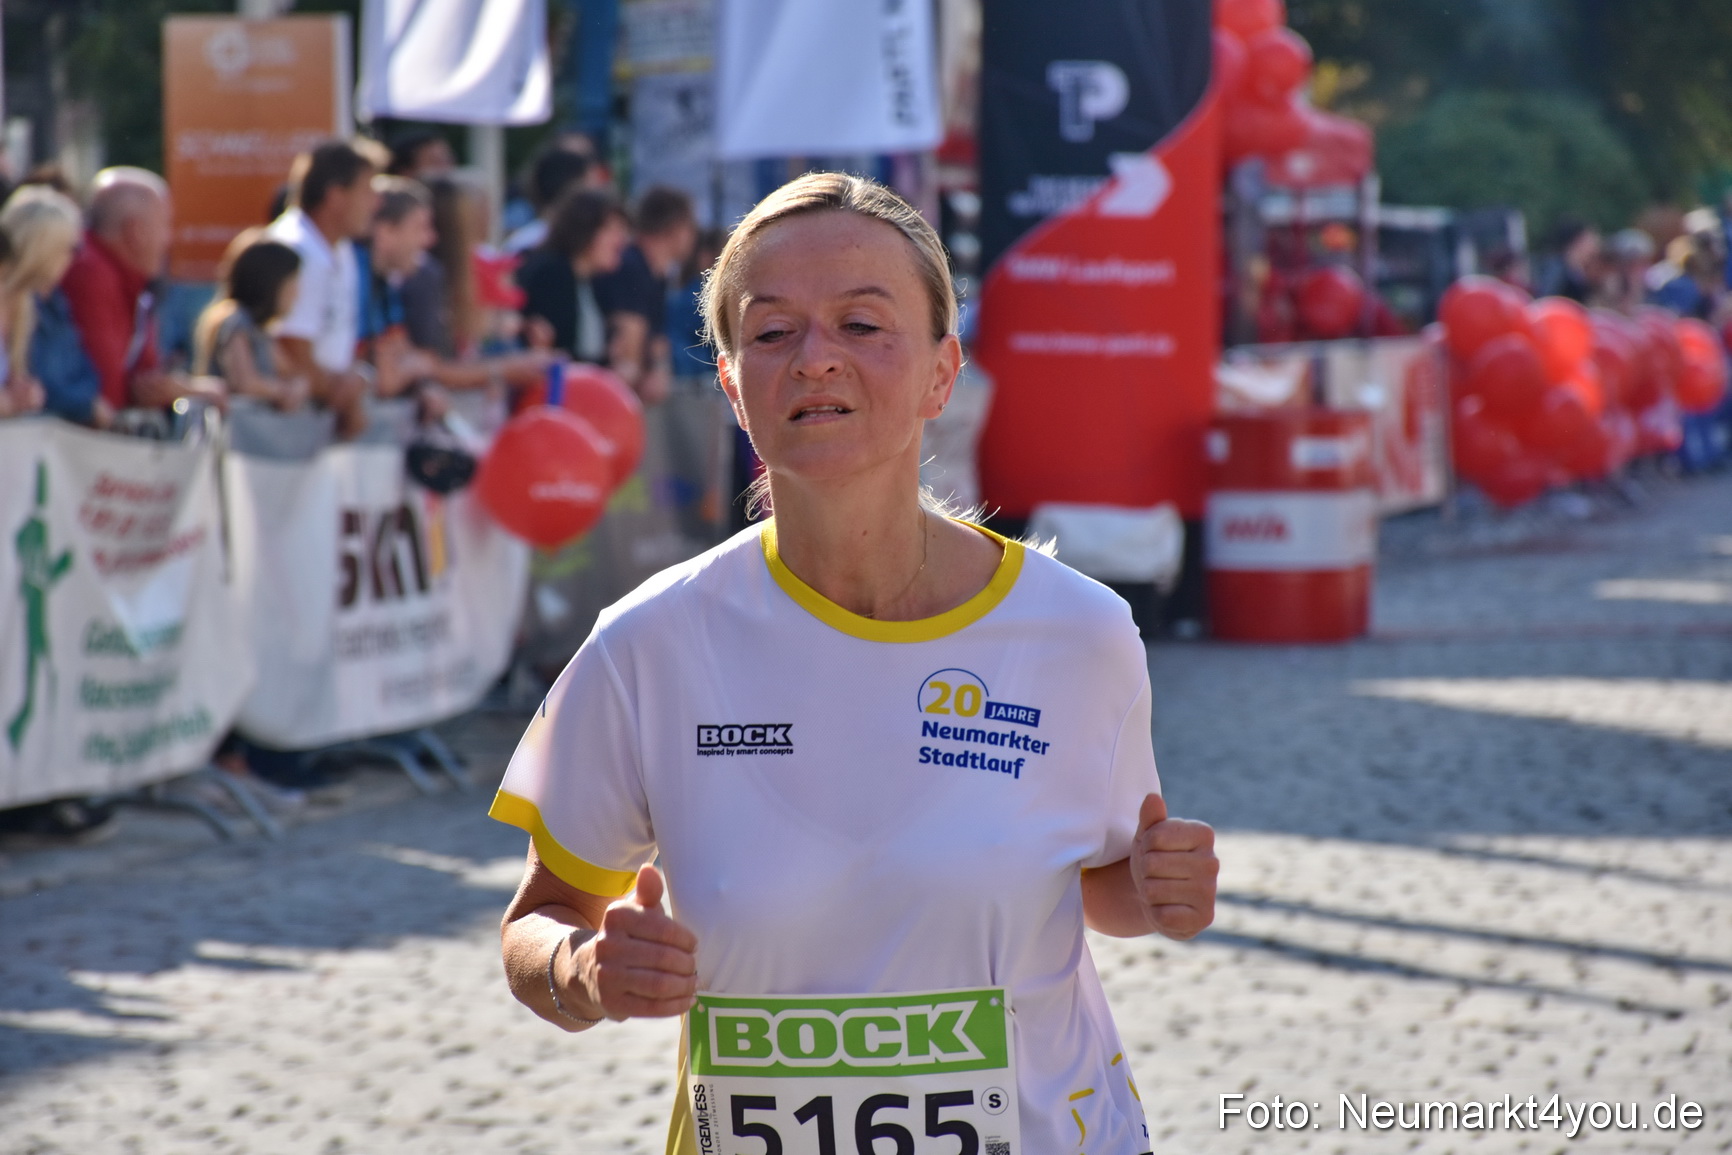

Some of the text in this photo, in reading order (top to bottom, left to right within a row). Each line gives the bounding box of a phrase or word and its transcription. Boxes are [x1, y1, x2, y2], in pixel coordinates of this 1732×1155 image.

[925, 681, 1036, 723] 20 JAHRE
[697, 724, 793, 748] BOCK
[697, 748, 793, 757] inspired by smart concepts
[921, 720, 1050, 755] Neumarkter
[918, 746, 1026, 780] Stadtlauf
[711, 1003, 978, 1063] BOCK
[730, 1090, 980, 1155] 5165
